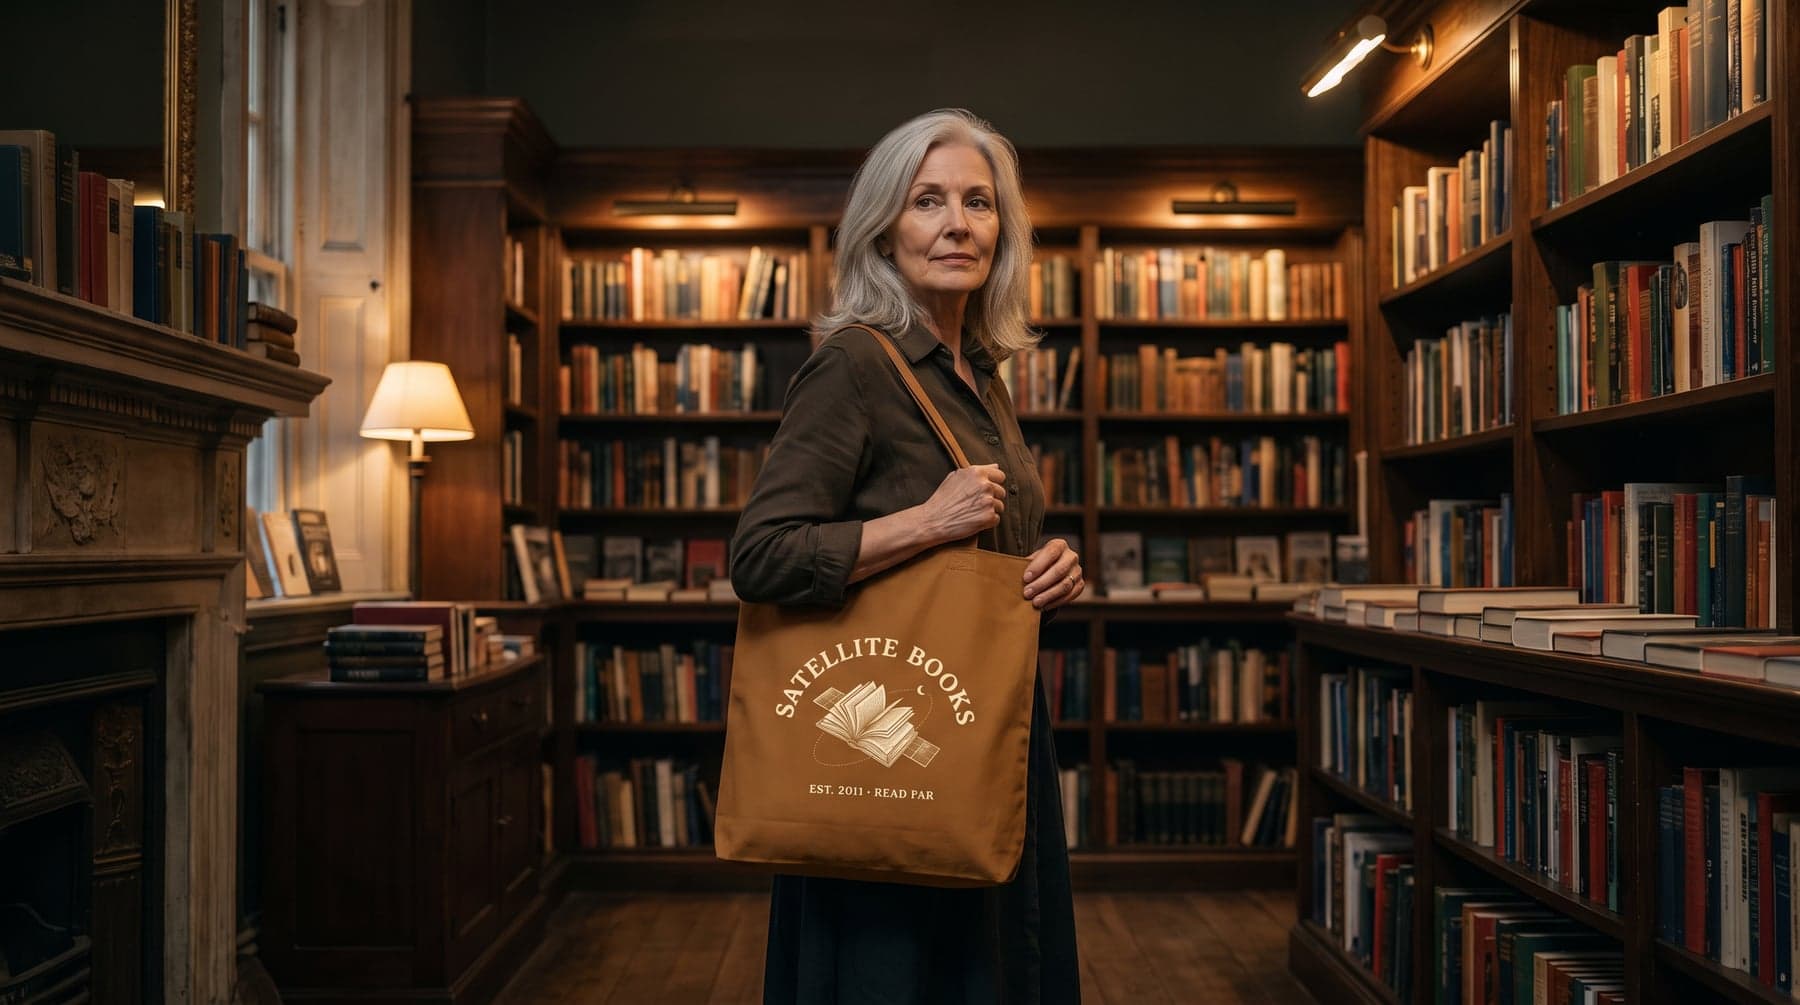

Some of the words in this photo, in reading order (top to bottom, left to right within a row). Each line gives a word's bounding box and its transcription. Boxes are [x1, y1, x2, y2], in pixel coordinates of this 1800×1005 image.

[775, 637, 899, 718] SATELLITE
[906, 645, 975, 726] BOOKS
[809, 784, 834, 795] EST.
[838, 785, 863, 796] 2011
[874, 787, 907, 799] READ
[910, 789, 935, 800] PAR
